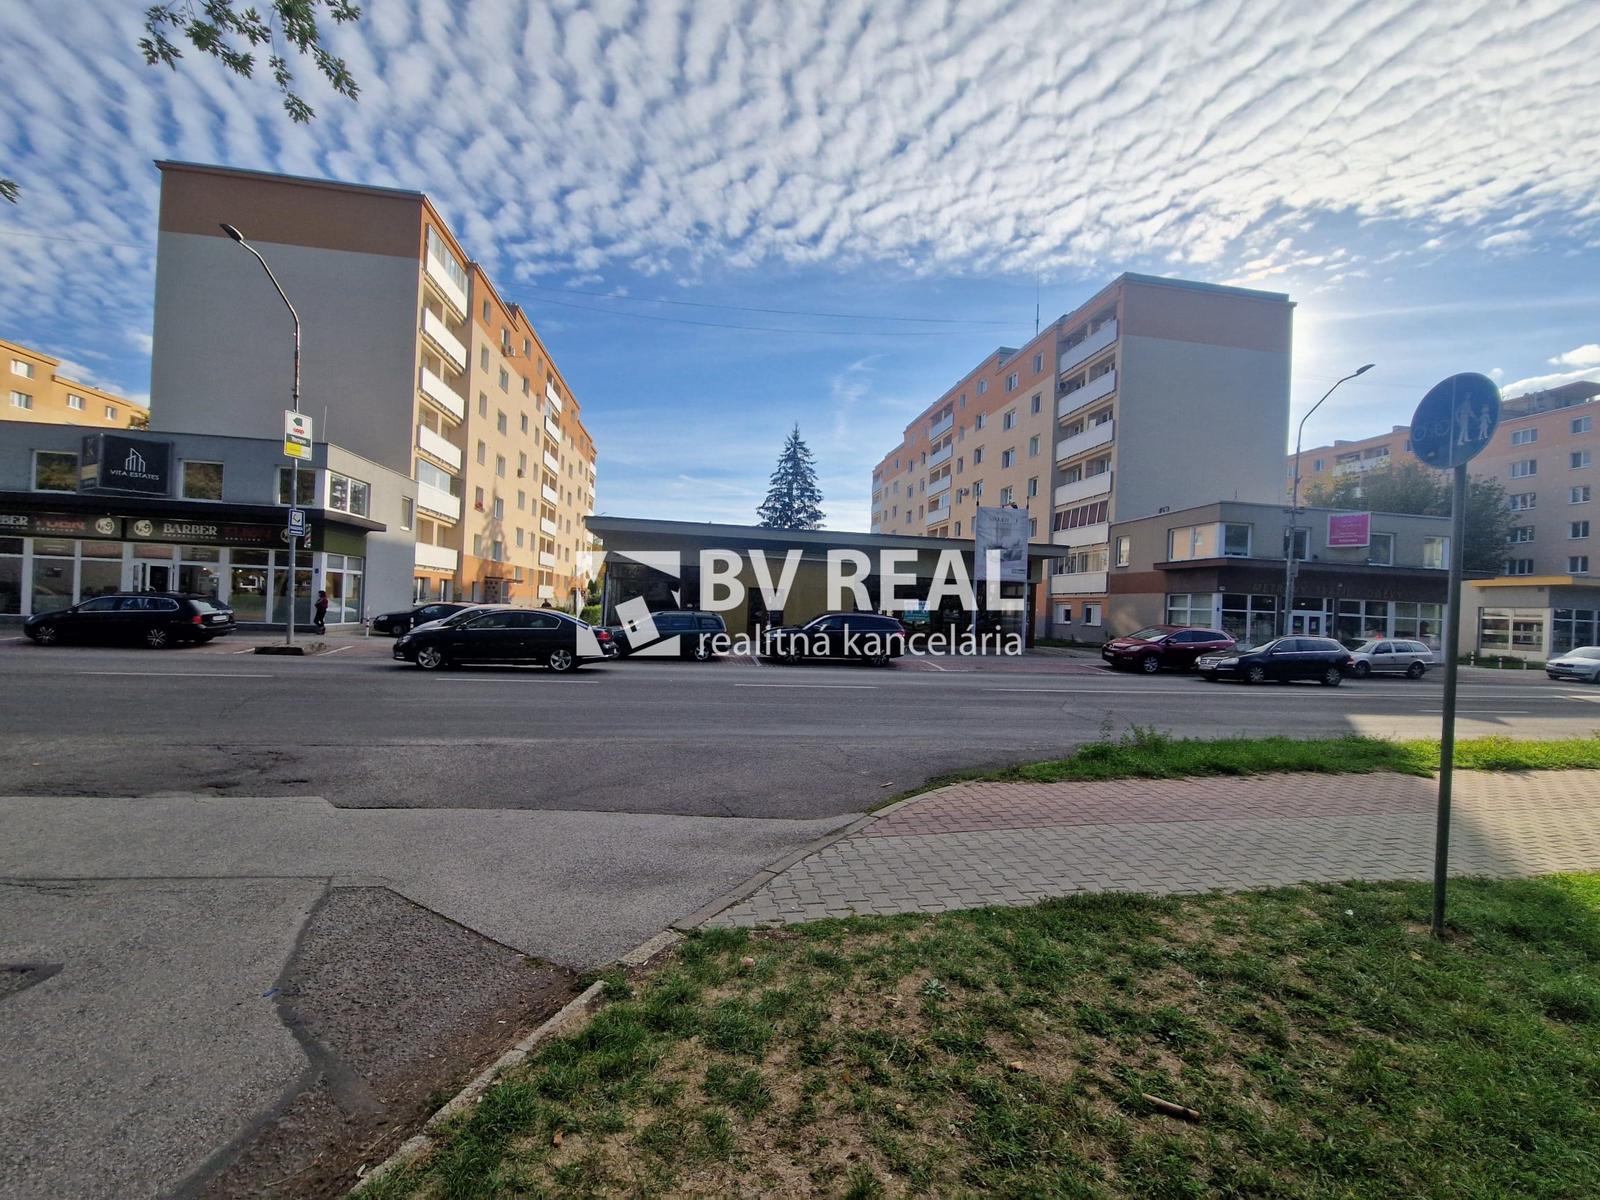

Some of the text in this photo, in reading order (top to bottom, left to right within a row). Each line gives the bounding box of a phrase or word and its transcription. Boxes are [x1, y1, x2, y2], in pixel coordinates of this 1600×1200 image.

[110, 469, 160, 481] VITA ESTATES
[163, 523, 218, 535] BARBER
